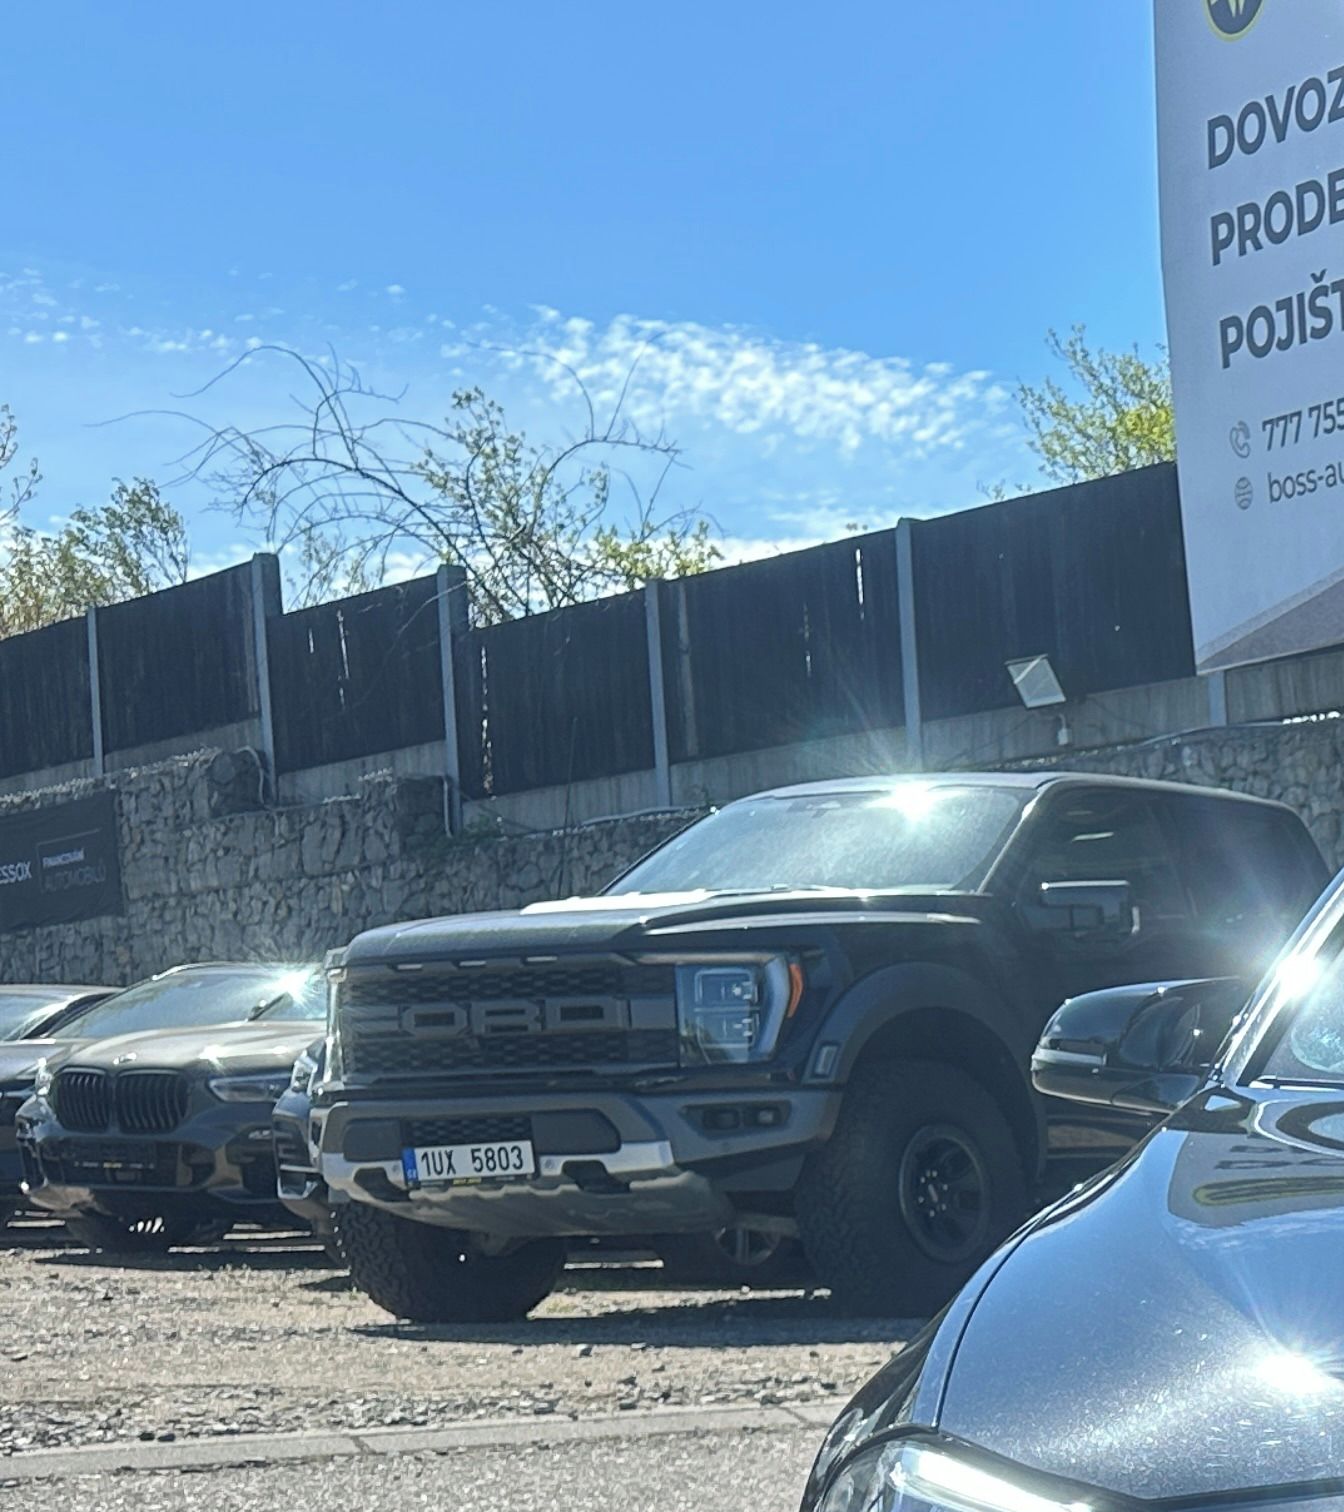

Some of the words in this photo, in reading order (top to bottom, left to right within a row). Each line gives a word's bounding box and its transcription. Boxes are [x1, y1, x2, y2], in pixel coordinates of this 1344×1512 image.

[1262, 411, 1302, 451] 777
[0, 861, 32, 884] SSOX
[421, 1149, 456, 1177] 1UX
[471, 1145, 524, 1173] 5803
